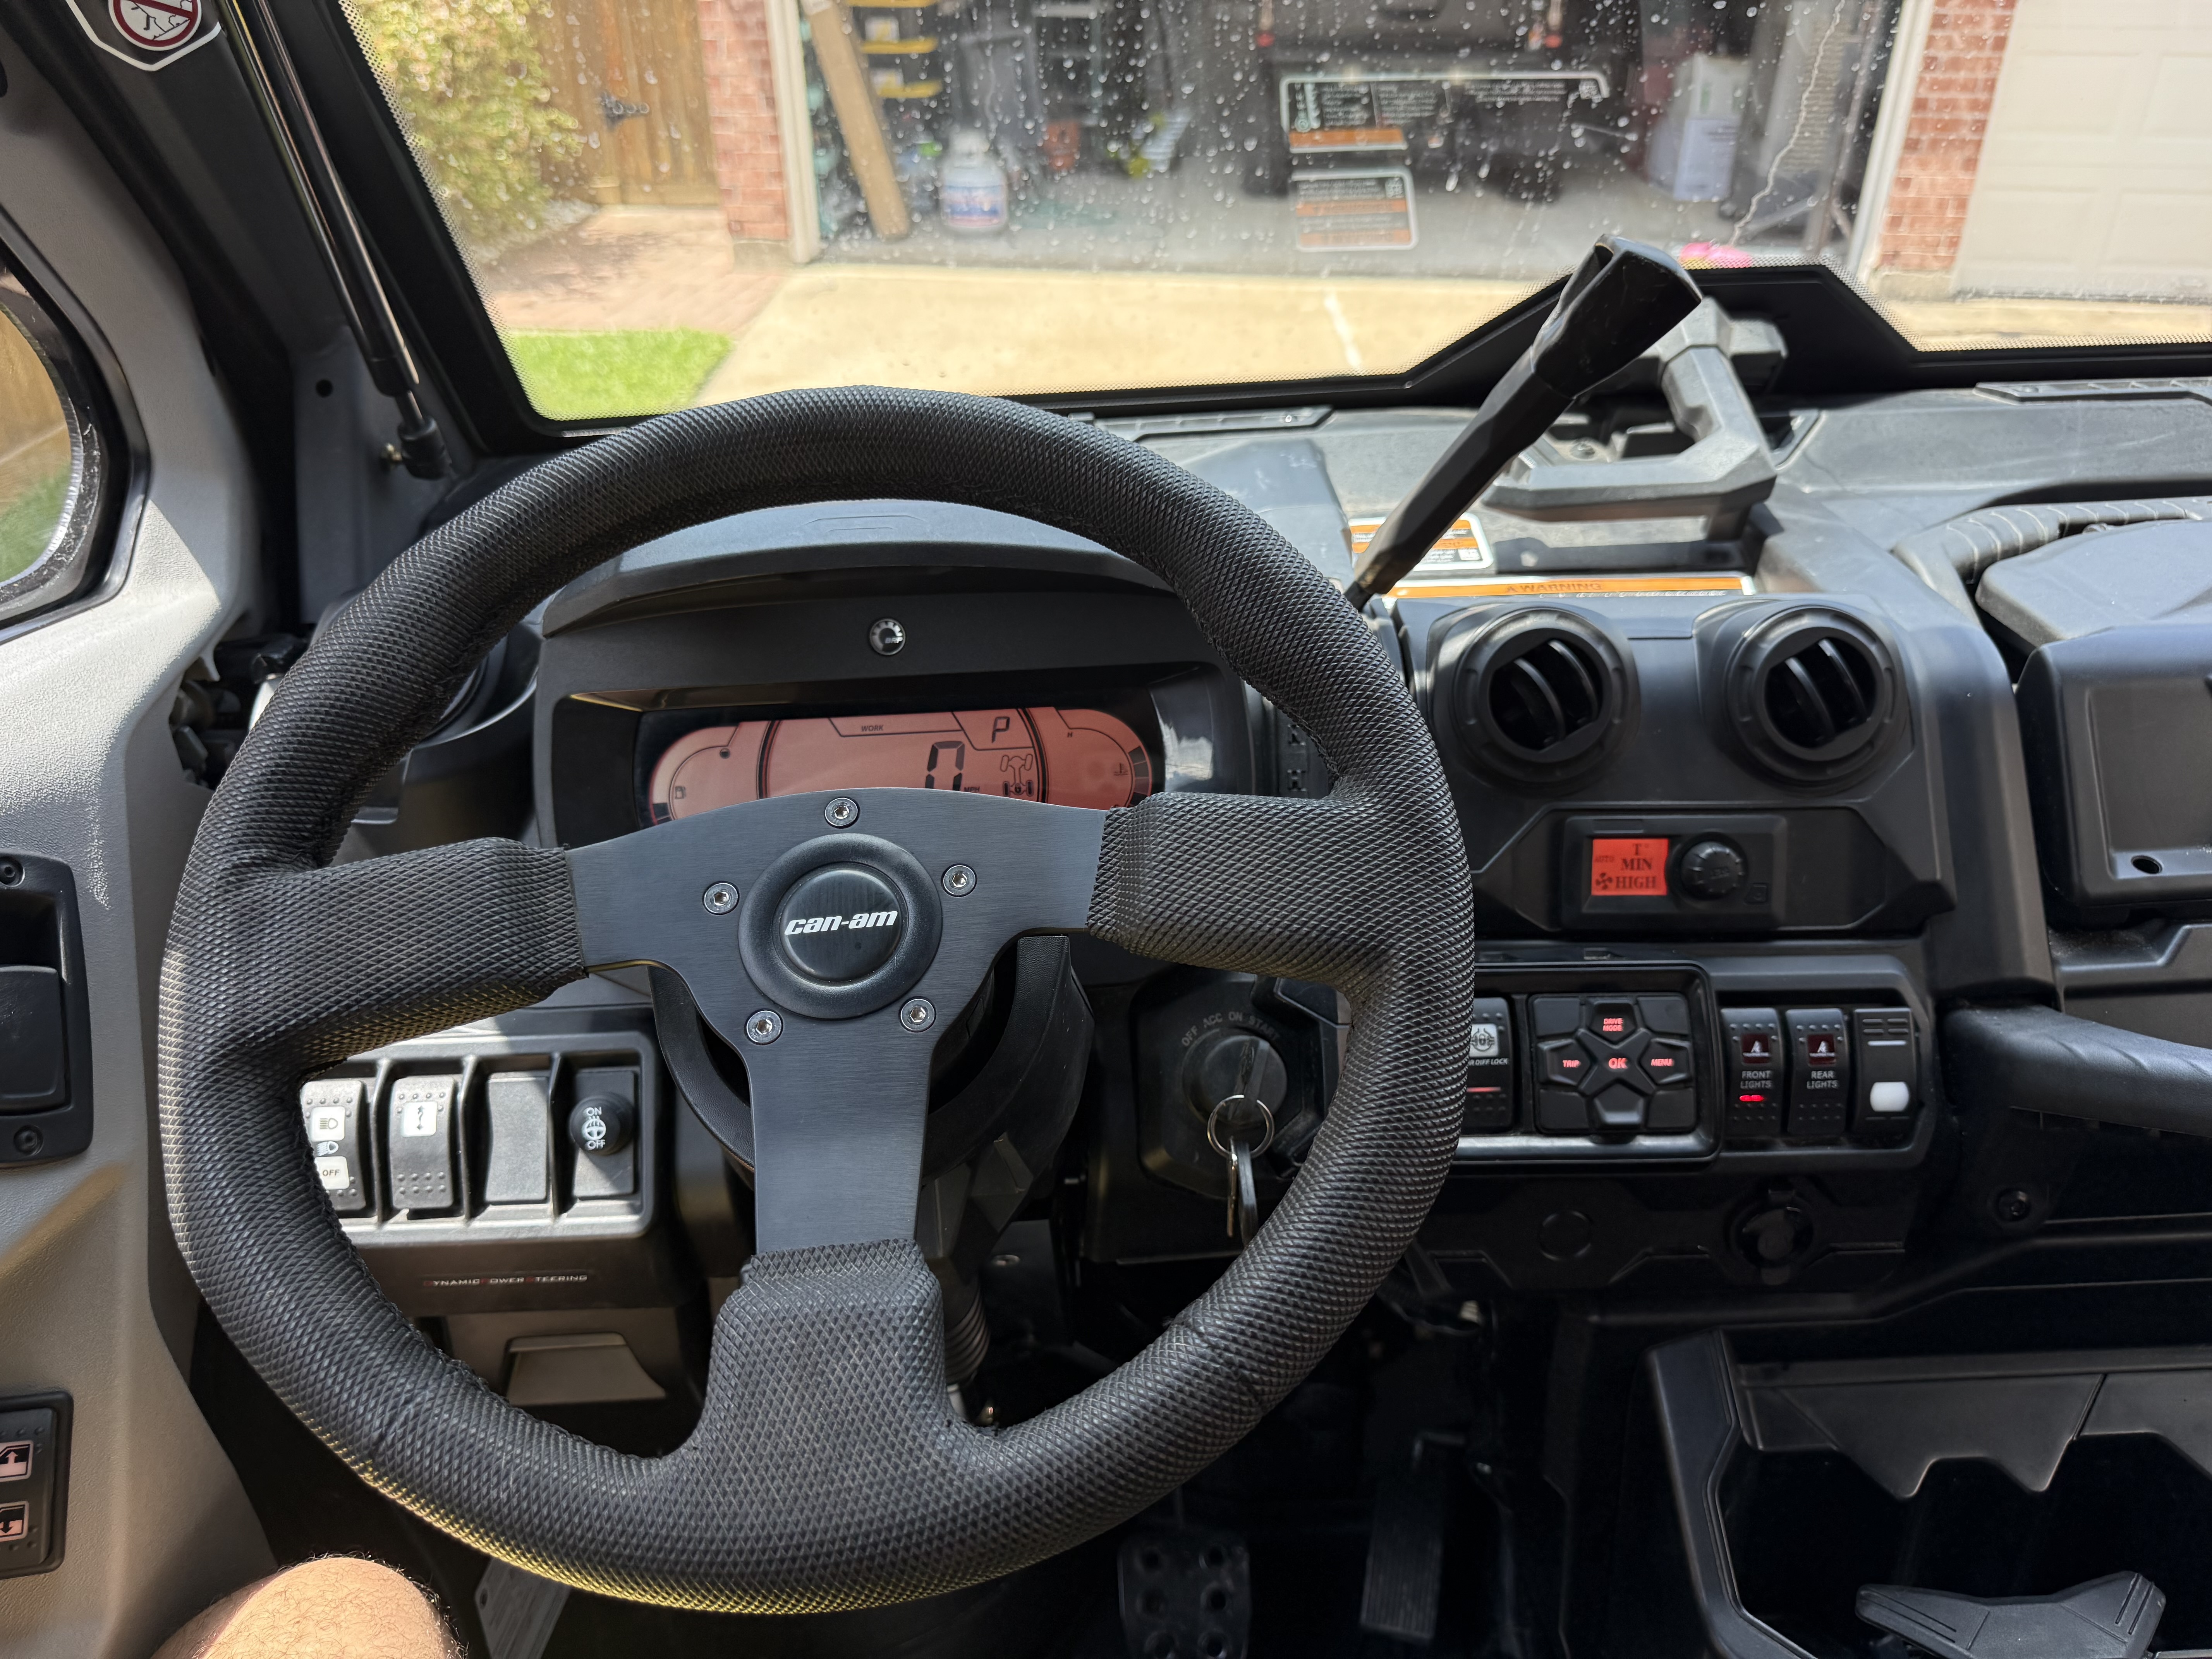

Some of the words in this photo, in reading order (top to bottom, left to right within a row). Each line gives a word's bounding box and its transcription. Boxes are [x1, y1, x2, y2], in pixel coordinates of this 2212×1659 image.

[1520, 583, 1602, 592] WARNING
[991, 716, 1010, 743] P
[1621, 858, 1653, 871] MIN
[1616, 876, 1657, 890] HIGH
[784, 911, 898, 935] can-am
[1182, 1025, 1198, 1046] OFF
[1202, 1013, 1223, 1028] ACC
[1228, 1012, 1243, 1022] ON
[1248, 1015, 1280, 1042] START
[1608, 1058, 1627, 1069] OK
[1651, 1058, 1674, 1066] MENU
[1741, 1070, 1771, 1080] FRONT
[1811, 1070, 1835, 1080] REAR
[1740, 1080, 1772, 1089] LIGHTS
[1806, 1080, 1839, 1089] LIGHTS
[584, 1106, 602, 1116] ON
[585, 1139, 606, 1151] OFF
